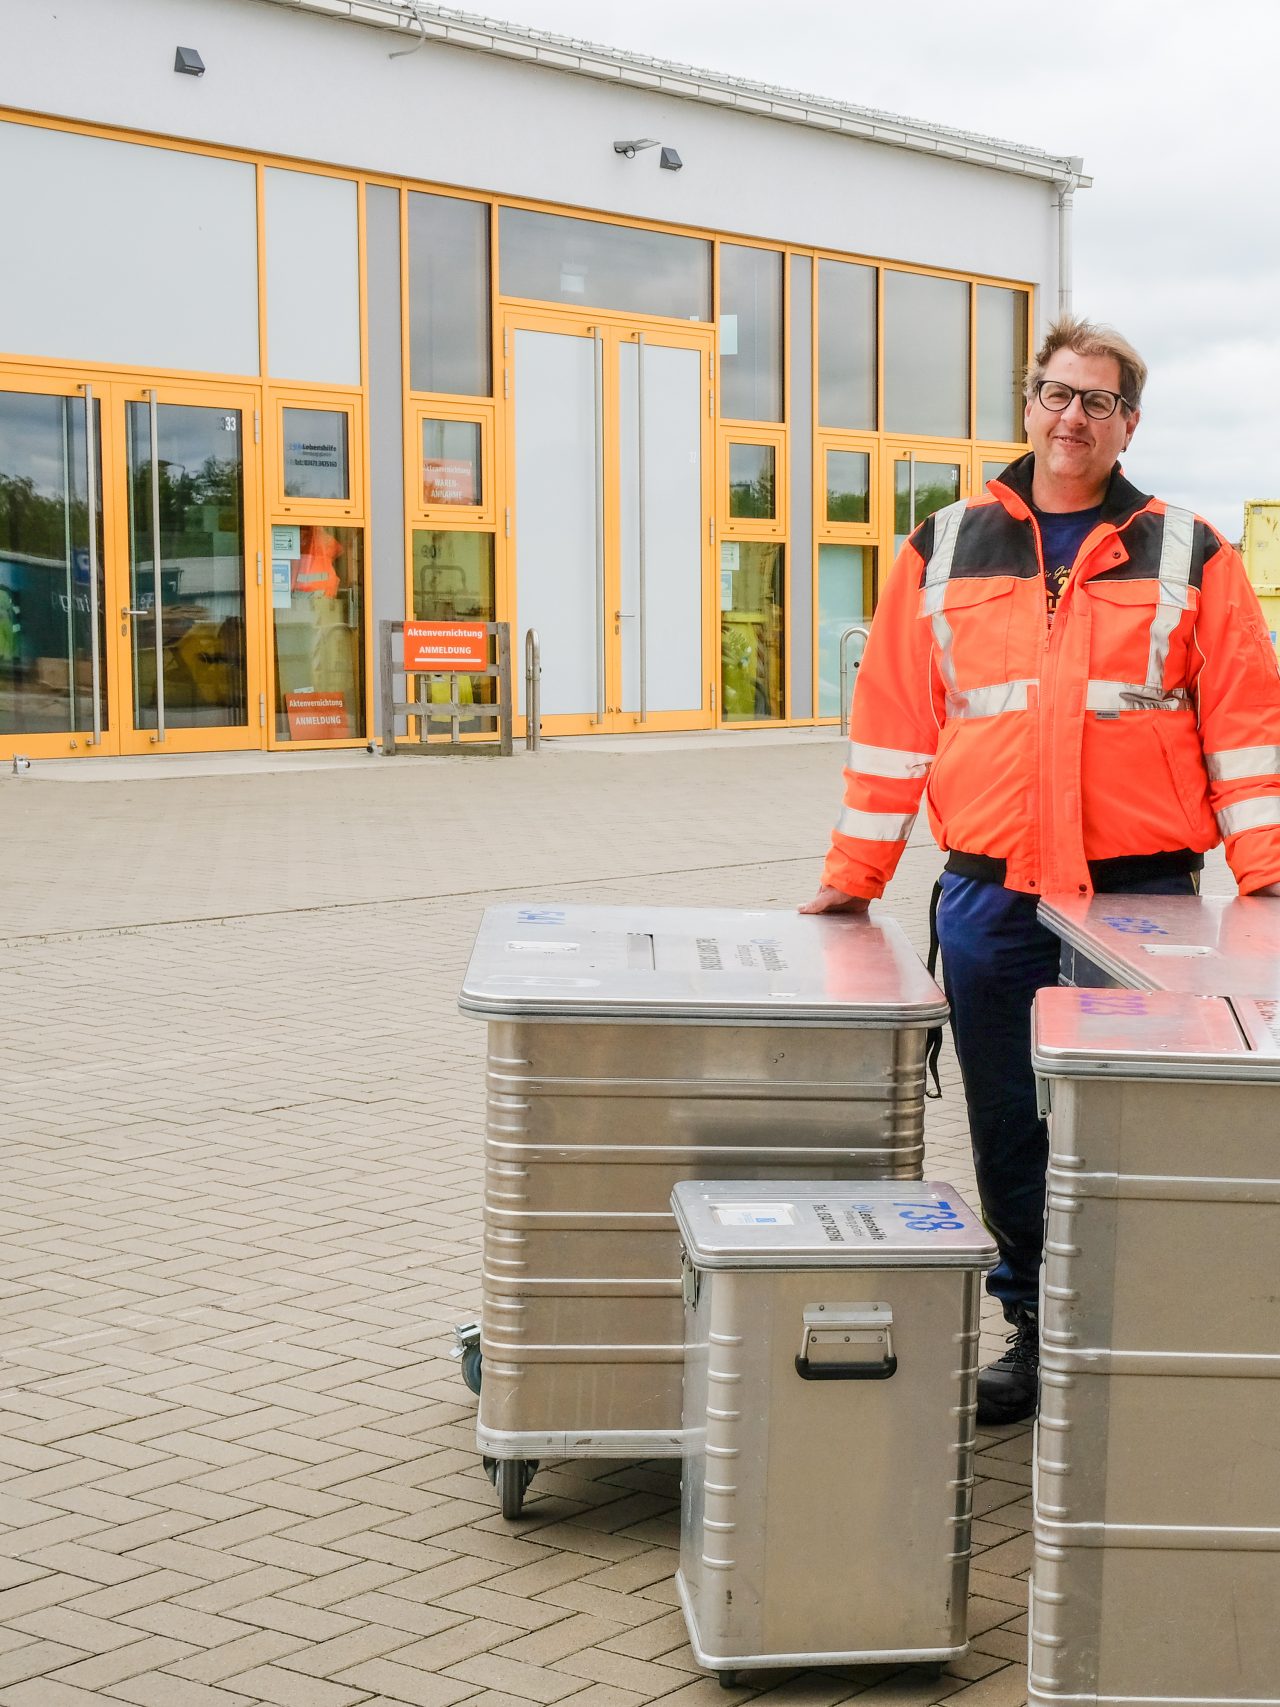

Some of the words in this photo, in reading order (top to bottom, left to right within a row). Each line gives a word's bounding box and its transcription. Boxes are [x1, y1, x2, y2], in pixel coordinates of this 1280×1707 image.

[225, 416, 236, 431] 33
[407, 628, 483, 639] Aktenvernichtung
[419, 646, 472, 655] ANMELDUNG
[289, 699, 343, 708] Aktenvernichtung
[295, 715, 341, 725] ANMELDUNG
[1079, 994, 1148, 1016] 323
[893, 1201, 965, 1232] 738
[858, 1210, 888, 1241] Lebenshilfe
